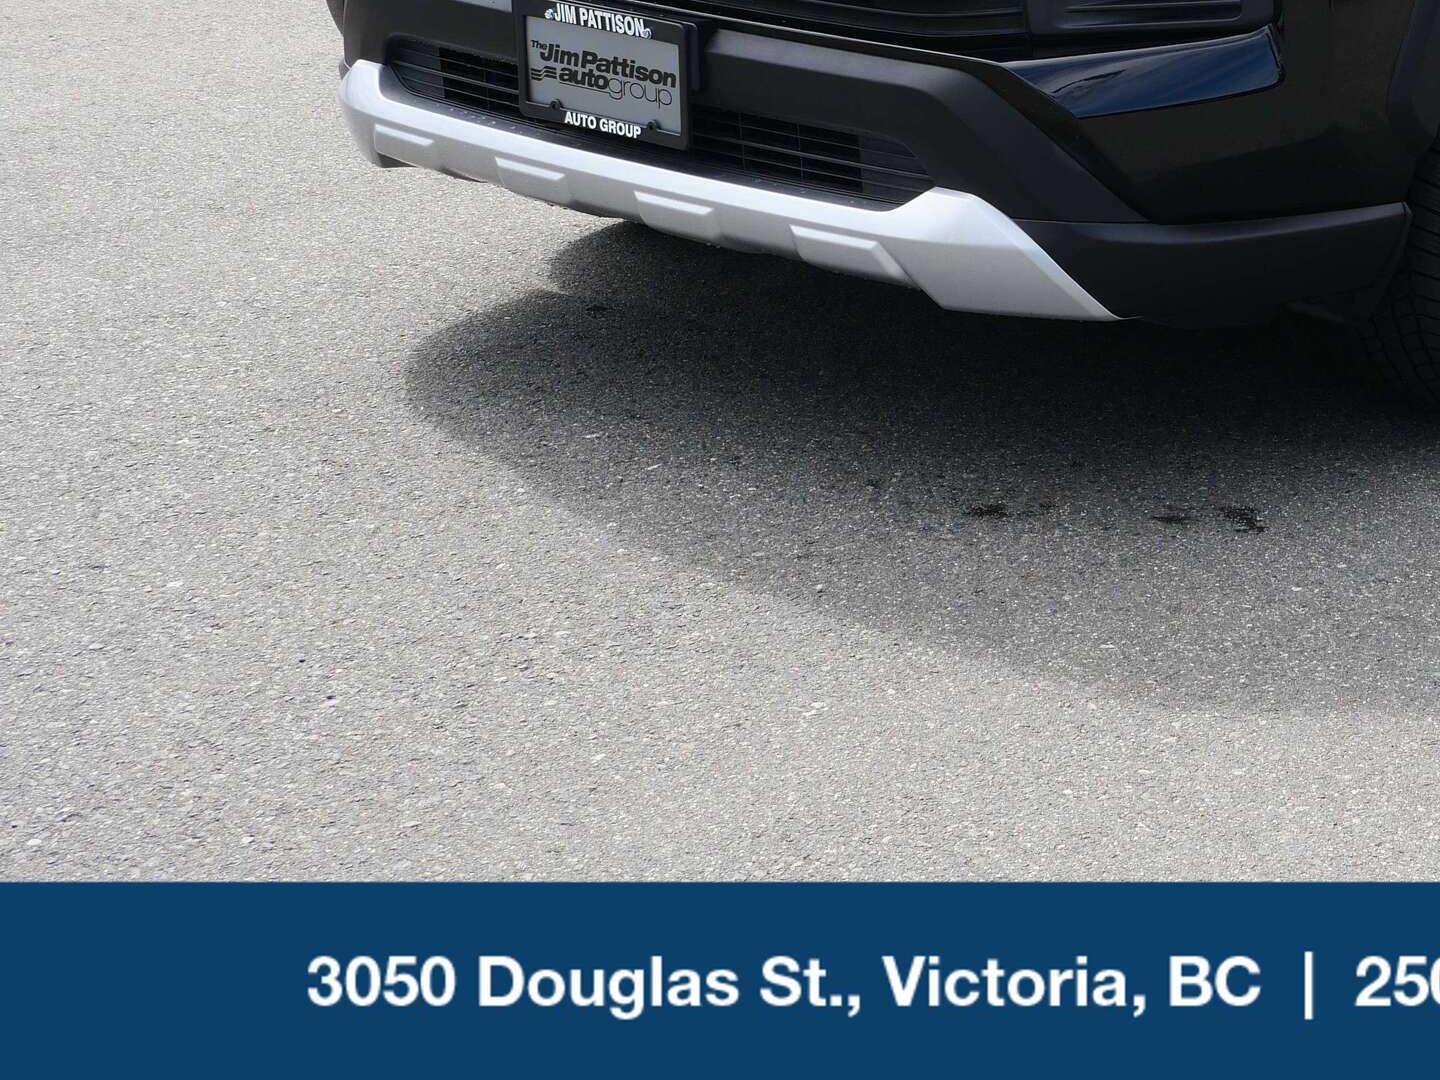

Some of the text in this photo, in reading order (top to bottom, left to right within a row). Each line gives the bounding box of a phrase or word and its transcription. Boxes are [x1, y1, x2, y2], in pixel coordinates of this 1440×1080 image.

[553, 3, 645, 38] JIM PATTISON
[530, 39, 548, 51] The
[564, 111, 642, 139] AUTO GROUP
